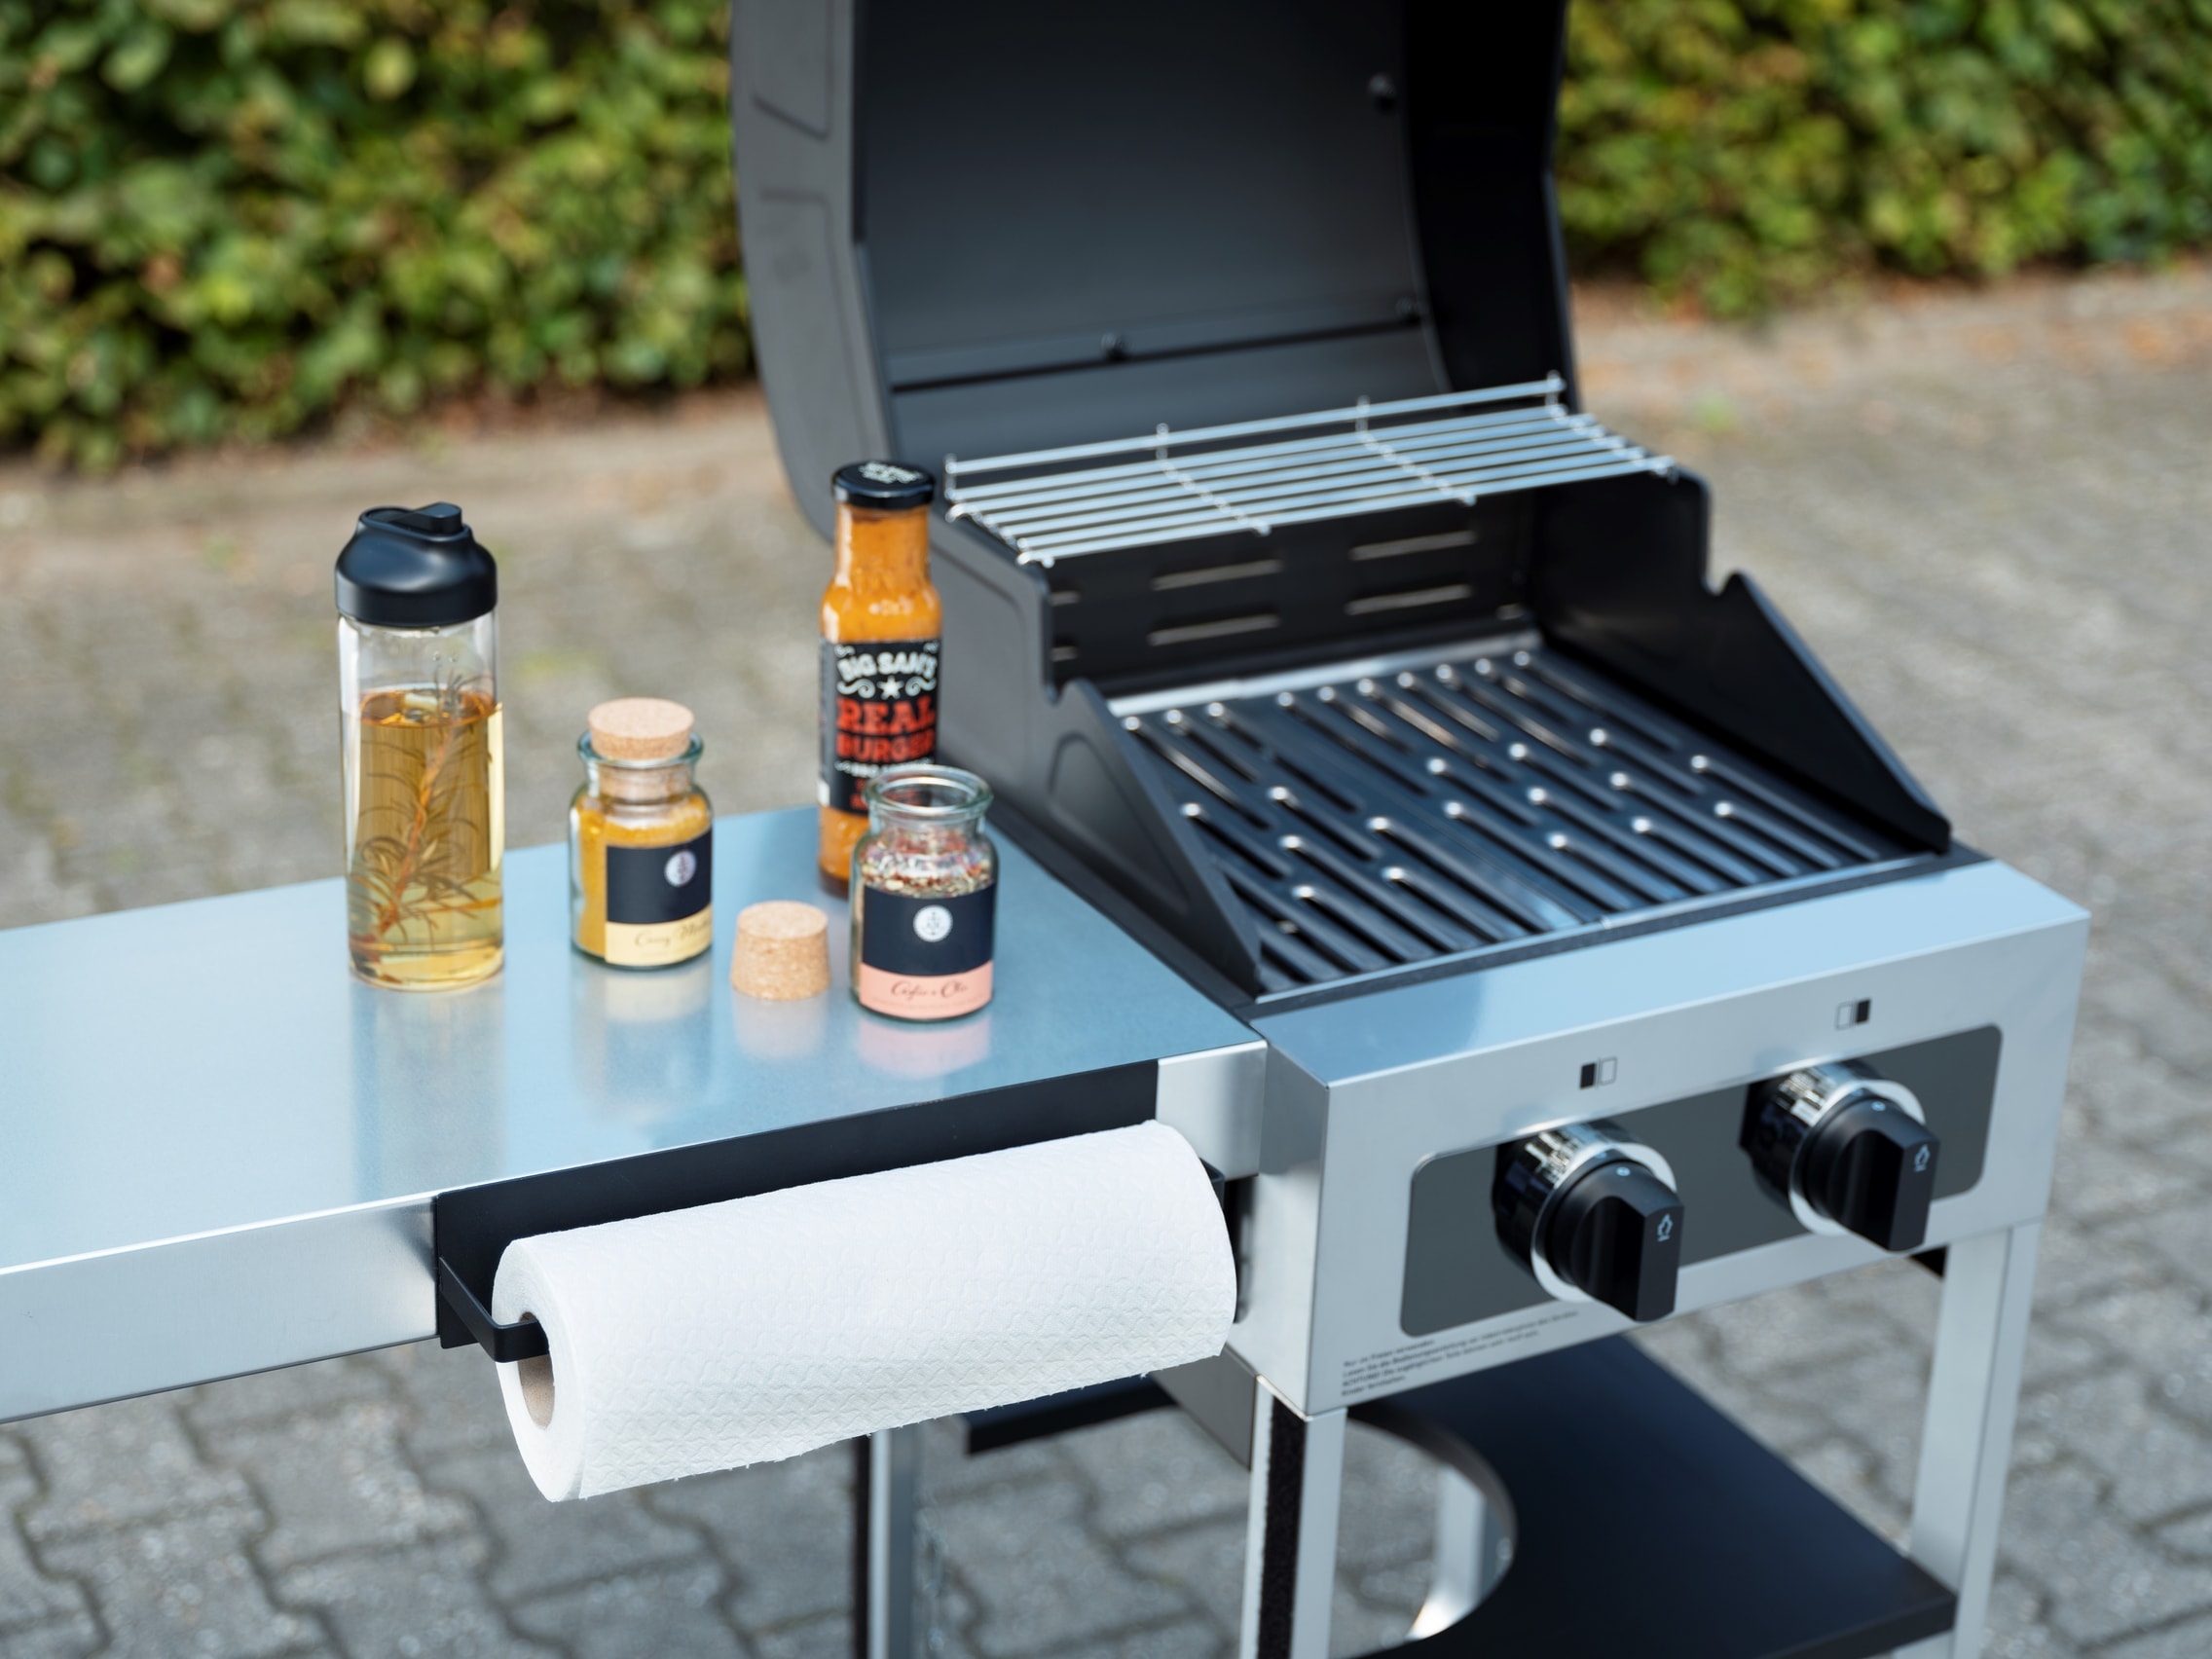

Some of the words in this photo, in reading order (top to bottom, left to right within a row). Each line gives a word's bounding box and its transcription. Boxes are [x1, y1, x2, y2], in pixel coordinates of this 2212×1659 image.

[837, 653, 877, 682] BIG
[877, 651, 938, 680] SAM'S
[836, 695, 936, 736] REAL
[836, 729, 936, 763] BURGER
